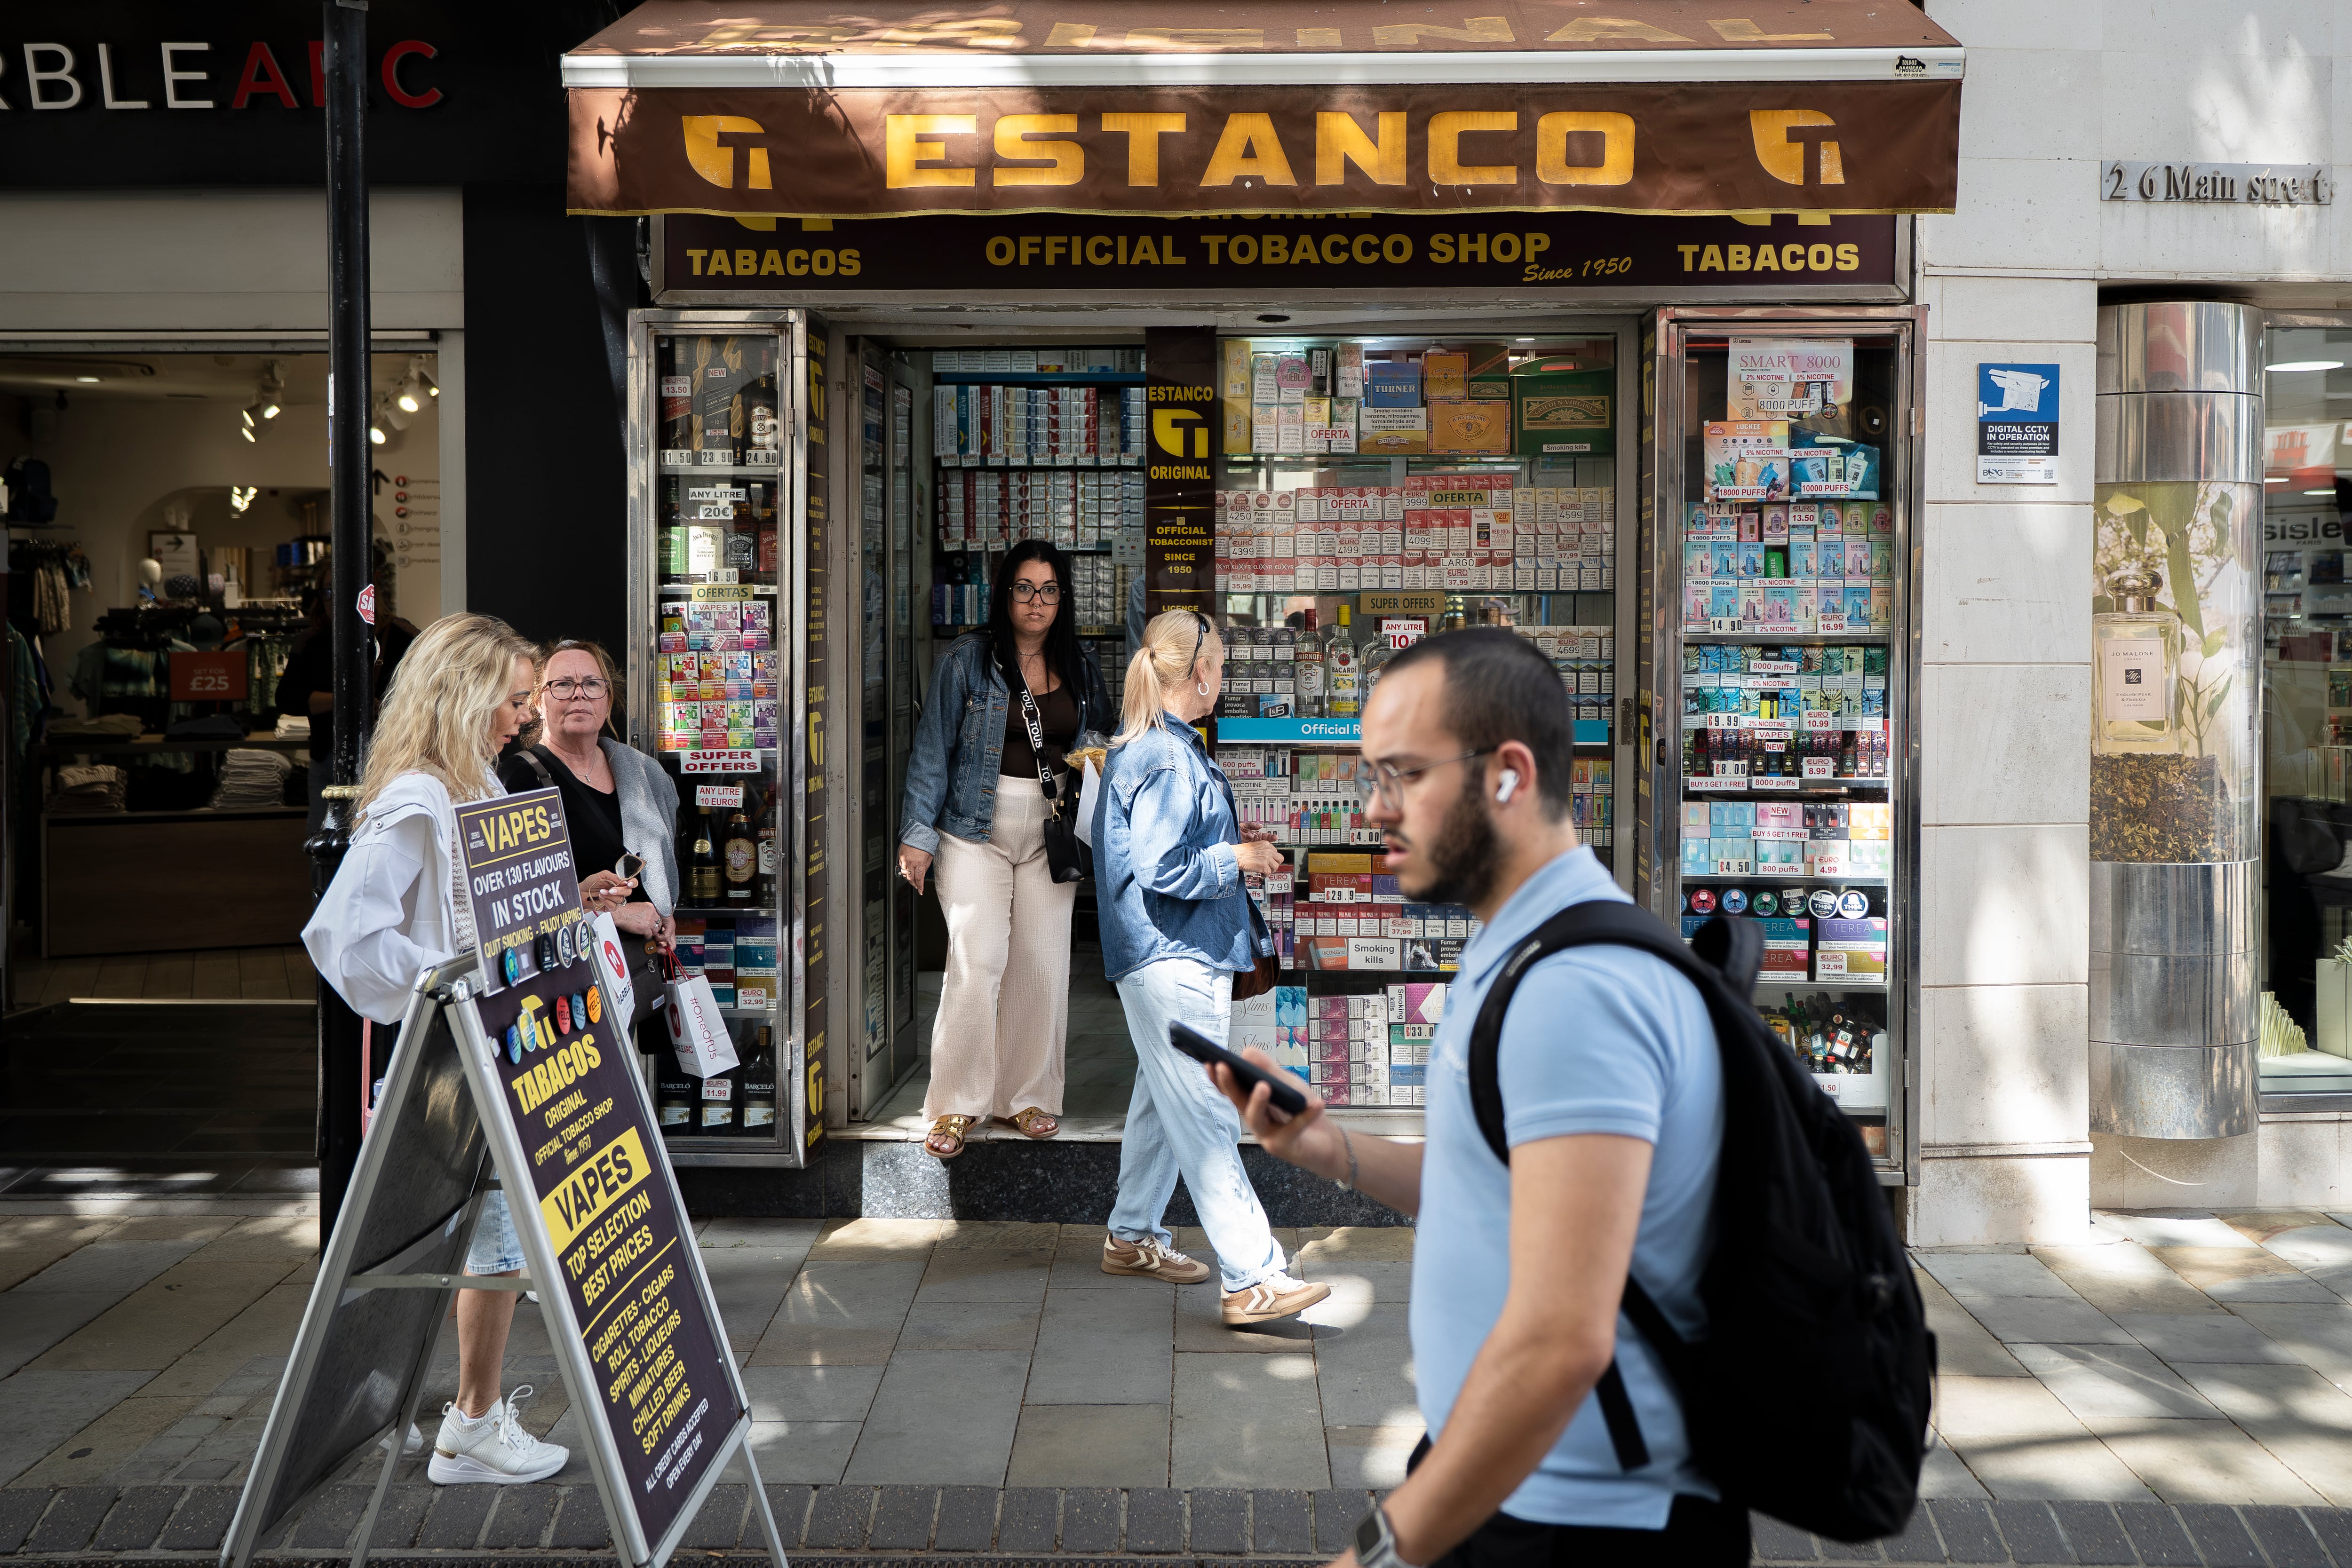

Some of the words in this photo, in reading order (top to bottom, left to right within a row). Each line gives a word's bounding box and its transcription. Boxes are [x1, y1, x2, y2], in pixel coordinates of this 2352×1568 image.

[886, 111, 1635, 188] ESTANCO
[2164, 165, 2238, 200] Main
[687, 249, 861, 276] TABACOS
[986, 236, 1186, 266] OFFICIAL
[1200, 234, 1413, 265] TOBACCO
[1430, 232, 1550, 263] SHOP
[1678, 245, 1859, 272] TABACOS
[1522, 262, 1575, 282] Since
[1581, 256, 1632, 277] 1950
[809, 333, 825, 357] ESTANCO
[1740, 355, 1798, 368] SMART
[1807, 356, 1840, 368] 8000
[1149, 386, 1213, 401] ESTANCO
[809, 426, 824, 445] ORIGINAL
[1311, 429, 1350, 439] OFERTA
[1151, 466, 1210, 479] ORIGINAL
[704, 507, 730, 517] 20€
[1156, 526, 1206, 535] OFFICIAL
[1442, 558, 1474, 567] LARGO
[697, 588, 748, 597] OFERTAS
[1370, 598, 1399, 609] SUPER
[1402, 597, 1435, 609] OFFERS
[1773, 663, 1794, 672] puffs
[190, 676, 229, 691] £25
[1030, 721, 1042, 749] TOUS
[1301, 723, 1350, 735] Official
[685, 762, 757, 771] OFFERS
[690, 751, 753, 760] SUPER
[479, 806, 550, 854] VAPES
[473, 871, 504, 896] OVER
[505, 868, 522, 887] 130
[523, 850, 570, 881] FLAVOURS
[492, 899, 511, 929] IN
[513, 880, 565, 921] STOCK
[484, 937, 501, 958] QUIT
[502, 926, 534, 950] SMOKING
[540, 918, 559, 934] ENJOY
[559, 907, 582, 927] VAPING
[1354, 944, 1394, 953] Smoking
[1365, 956, 1384, 964] kills
[511, 1033, 601, 1116] TABACOS
[545, 1088, 587, 1129] ORIGINAL
[535, 1137, 563, 1166] OFFICIAL
[563, 1112, 595, 1142] TOBACCO
[594, 1097, 613, 1120] SHOP
[564, 1147, 579, 1166] Since
[578, 1134, 591, 1156] 1950
[554, 1144, 633, 1233] VAPES
[567, 1244, 587, 1281] TOP
[587, 1189, 652, 1257] SELECTION
[582, 1268, 611, 1307] BEST
[610, 1225, 653, 1282] PRICES
[592, 1300, 638, 1363] CIGARETTES
[642, 1264, 675, 1307] CIGARS
[608, 1340, 631, 1374] ROLL
[628, 1296, 669, 1345] TOBACCO
[610, 1361, 639, 1403] SPIRITS
[642, 1308, 681, 1364] LIQUEURS
[628, 1343, 675, 1410] MINIATURES
[633, 1391, 666, 1437] CHILLED
[663, 1359, 686, 1394] BEER
[642, 1420, 663, 1455] SOFT
[661, 1382, 691, 1428] DRINKS
[646, 1472, 657, 1494] ALL
[654, 1449, 671, 1480] CREDIT
[670, 1424, 686, 1454] CARDS
[685, 1398, 709, 1432] ACCEPTED
[666, 1467, 680, 1489] OPEN
[678, 1445, 694, 1473] EVERY
[692, 1430, 703, 1451] DAY
